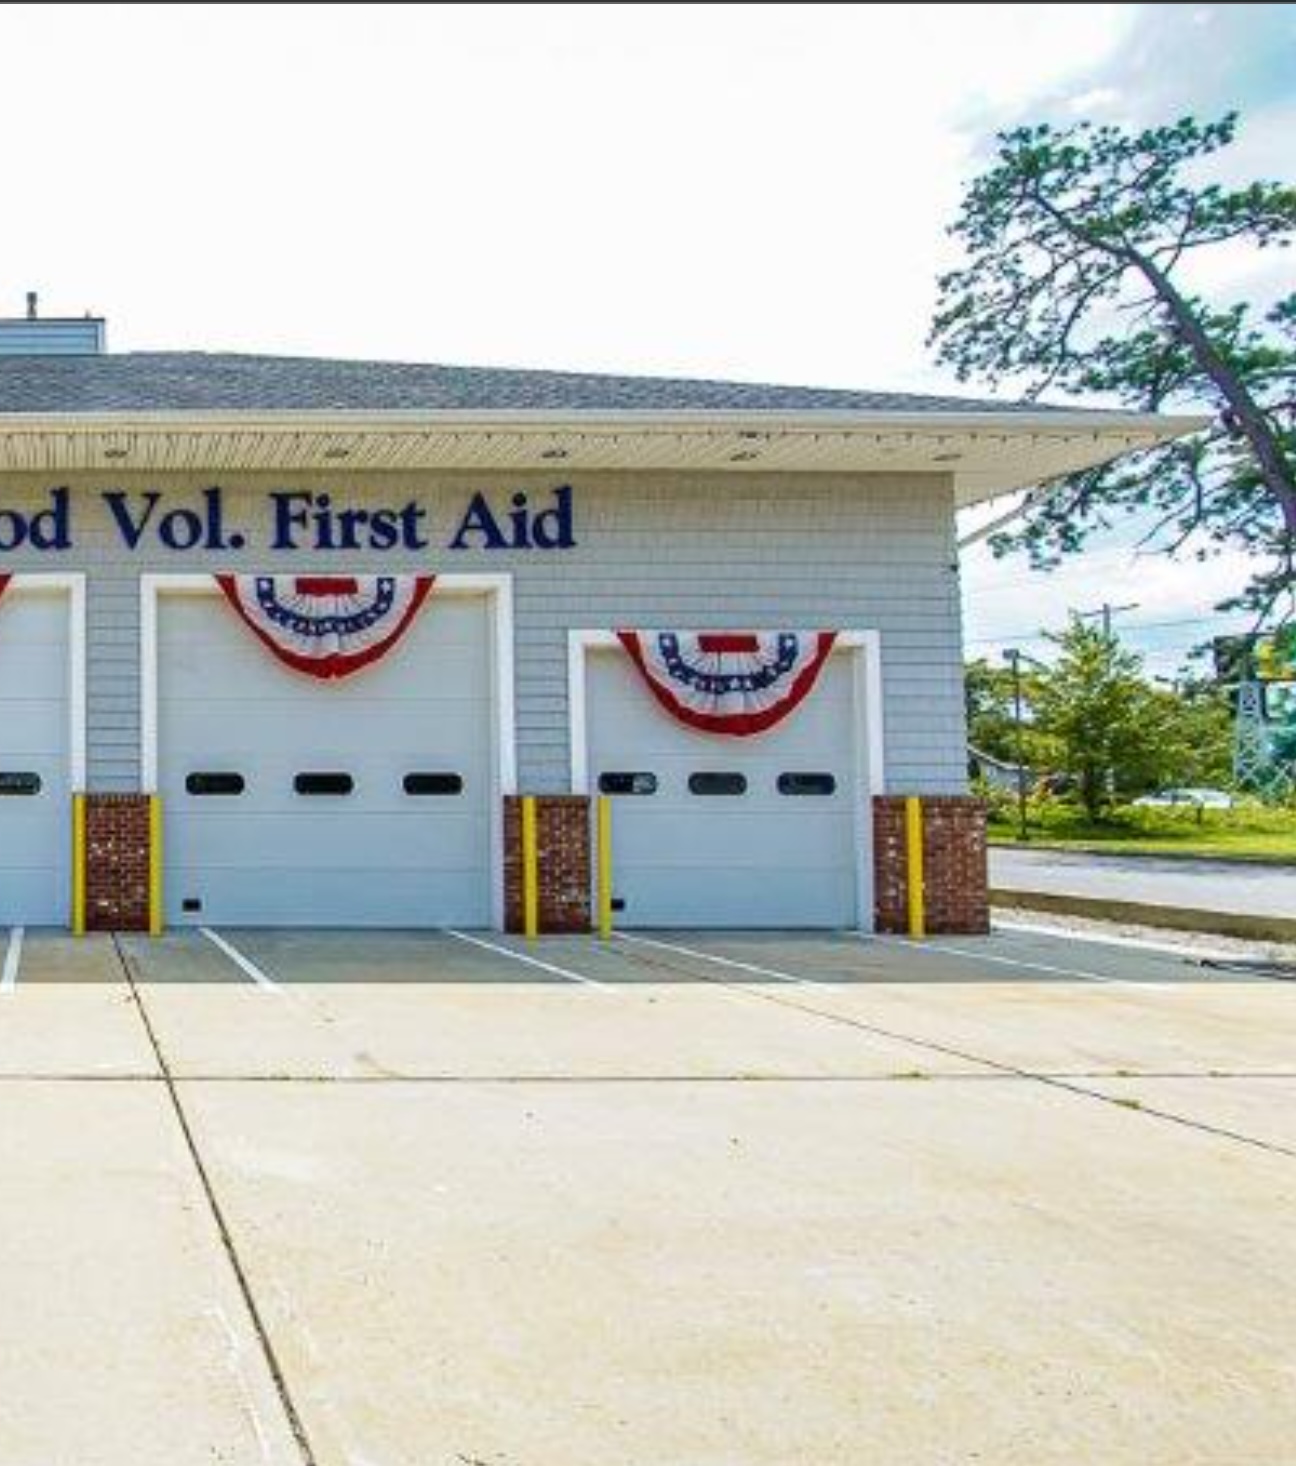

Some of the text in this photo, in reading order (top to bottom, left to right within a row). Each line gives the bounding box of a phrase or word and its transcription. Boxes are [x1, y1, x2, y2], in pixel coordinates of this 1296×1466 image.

[103, 489, 244, 553] Vol.
[268, 490, 428, 553] First
[448, 486, 577, 553] Aid
